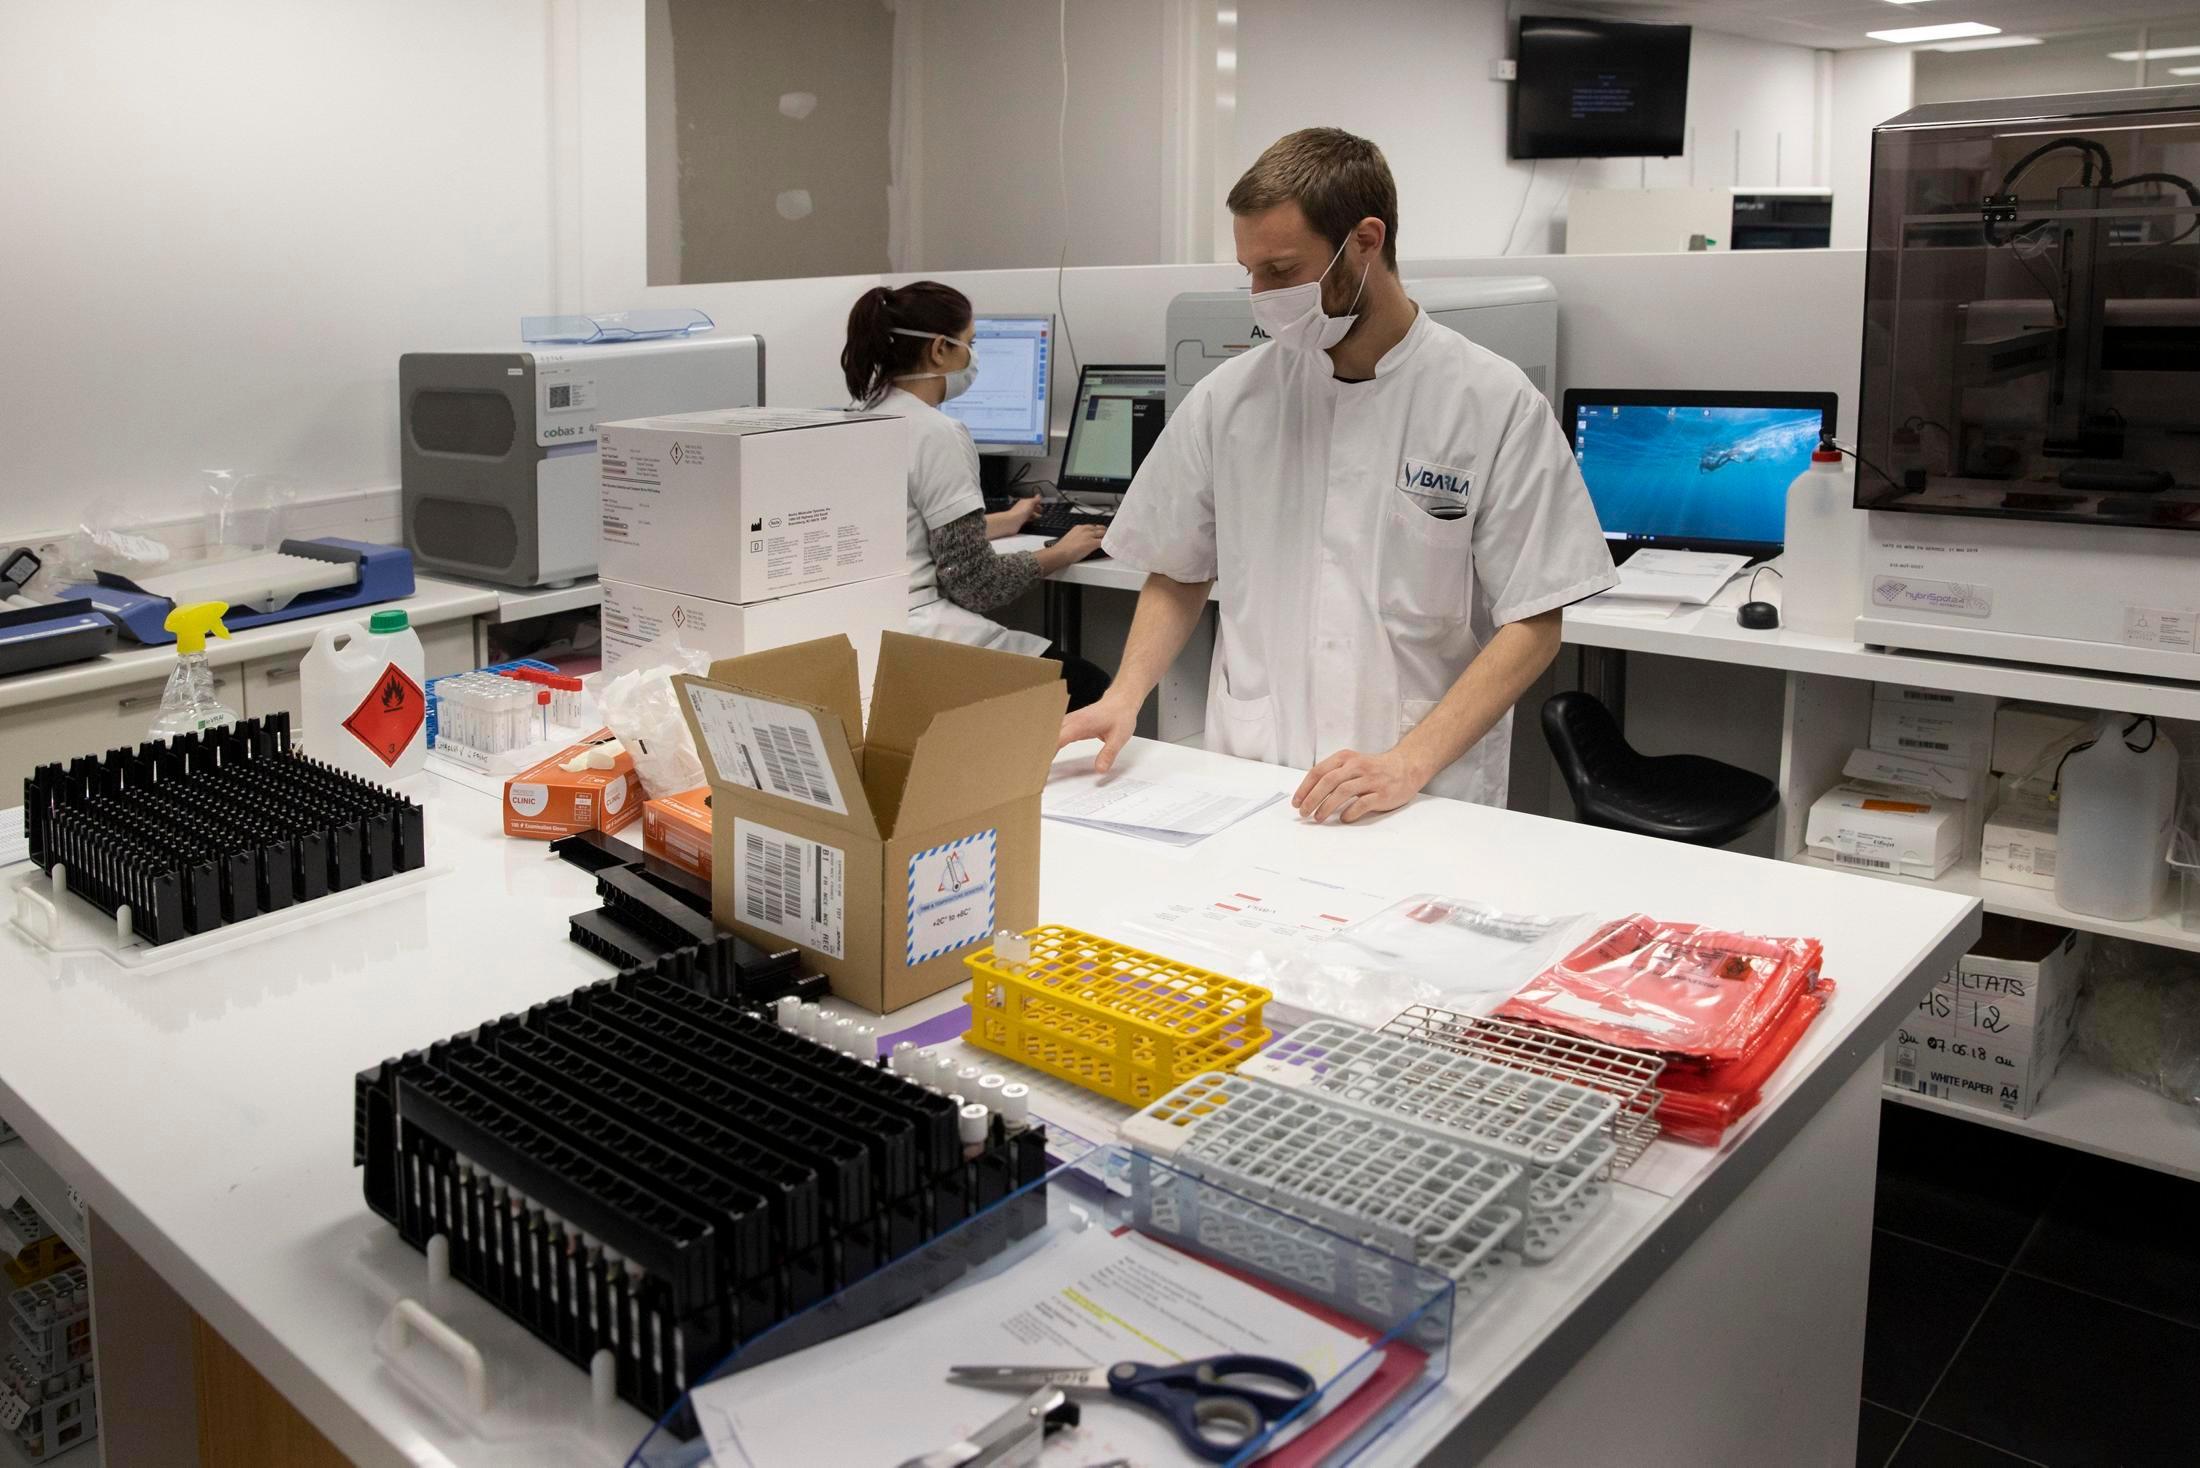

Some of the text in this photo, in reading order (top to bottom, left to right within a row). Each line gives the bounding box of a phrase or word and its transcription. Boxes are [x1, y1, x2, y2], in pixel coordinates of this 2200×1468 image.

[544, 423, 597, 438] cobas z 4
[1420, 470, 1469, 497] BARLA
[388, 743, 395, 753] 3
[512, 797, 536, 805] CLINIC
[1930, 1072, 2019, 1101] WHITE PAPER A4
